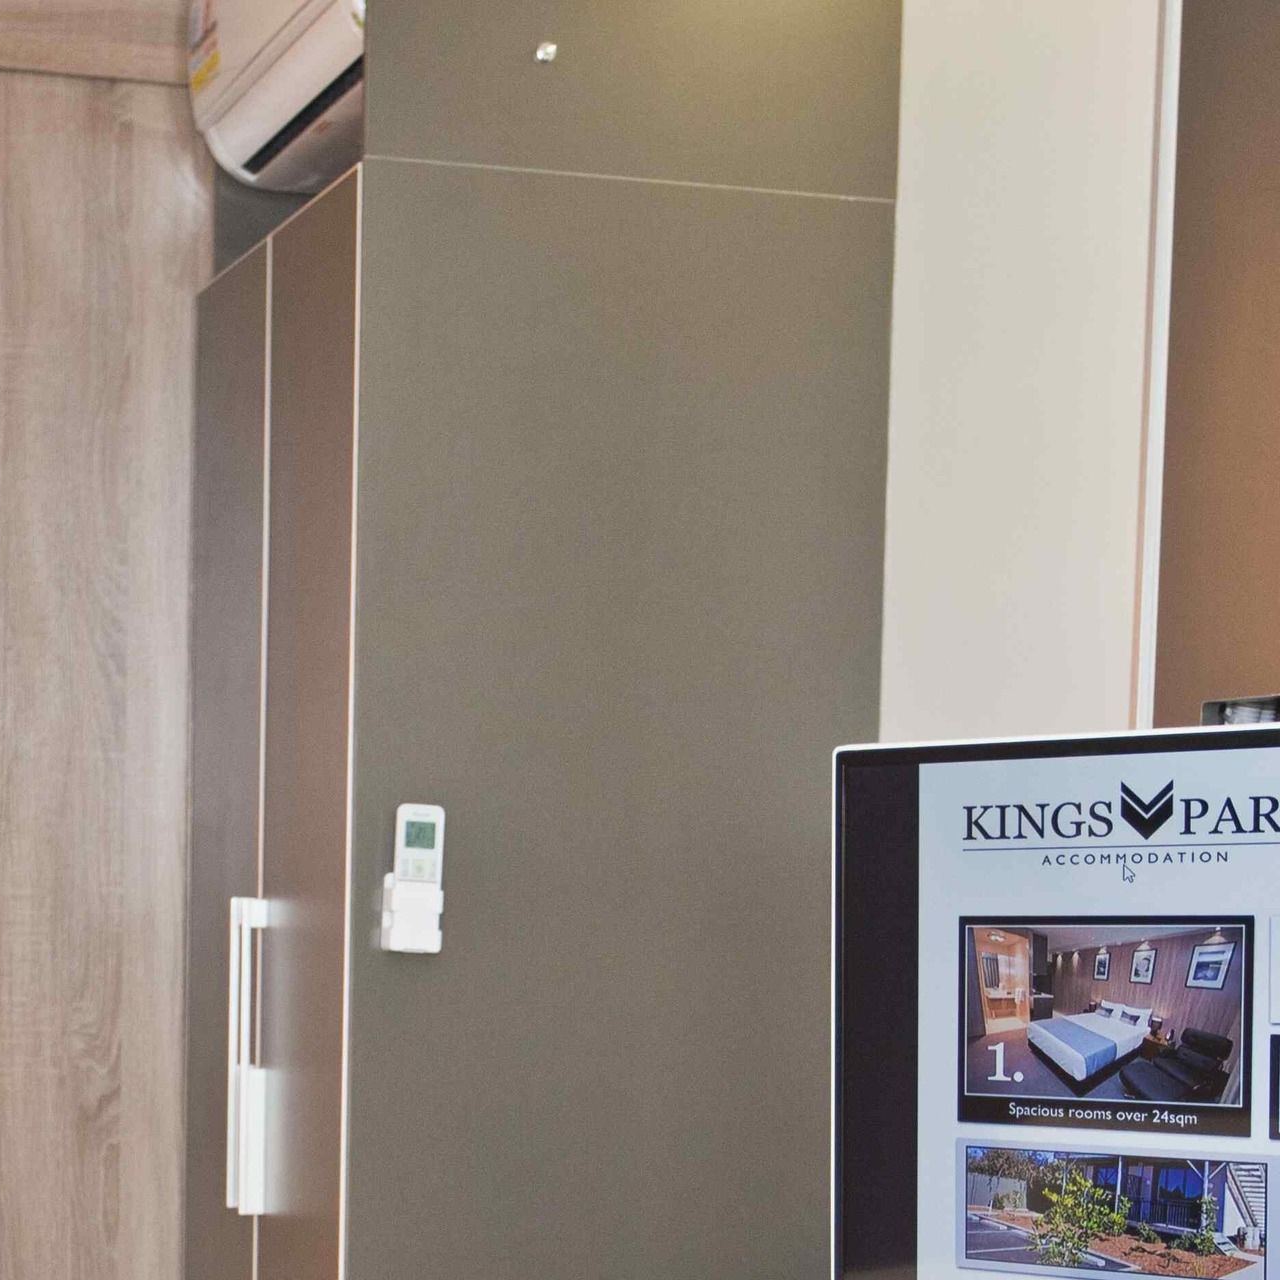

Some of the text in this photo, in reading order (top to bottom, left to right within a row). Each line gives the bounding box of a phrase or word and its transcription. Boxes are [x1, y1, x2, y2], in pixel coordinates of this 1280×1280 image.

[962, 800, 1113, 841] KINGS
[1041, 850, 1229, 867] ACCOMMODATION
[986, 1041, 1025, 1083] 1.
[1008, 1102, 1198, 1127] Spacious rooms over 24sqm
